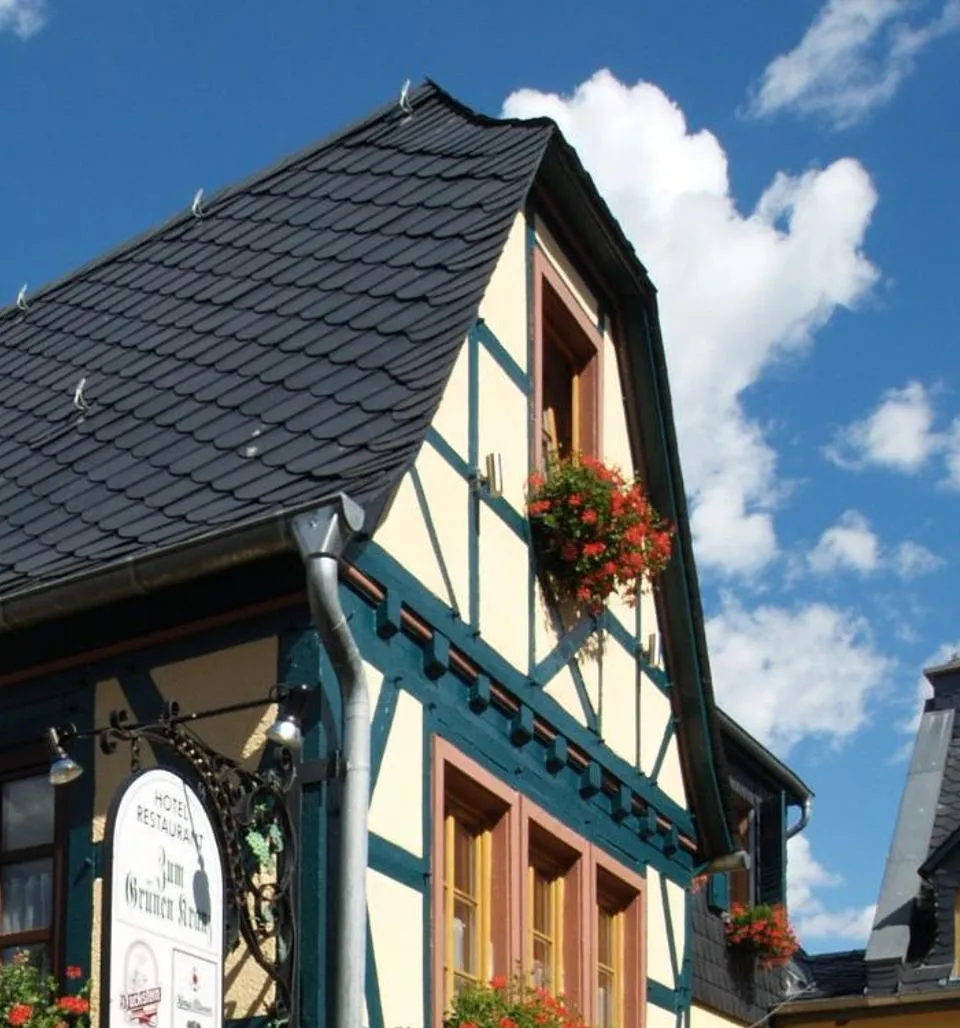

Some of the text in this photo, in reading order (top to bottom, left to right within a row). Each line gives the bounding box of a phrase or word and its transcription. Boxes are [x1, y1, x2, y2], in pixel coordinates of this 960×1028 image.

[155, 790, 189, 821] HOTEL
[157, 846, 185, 891] Zum
[125, 871, 174, 921] Grünen
